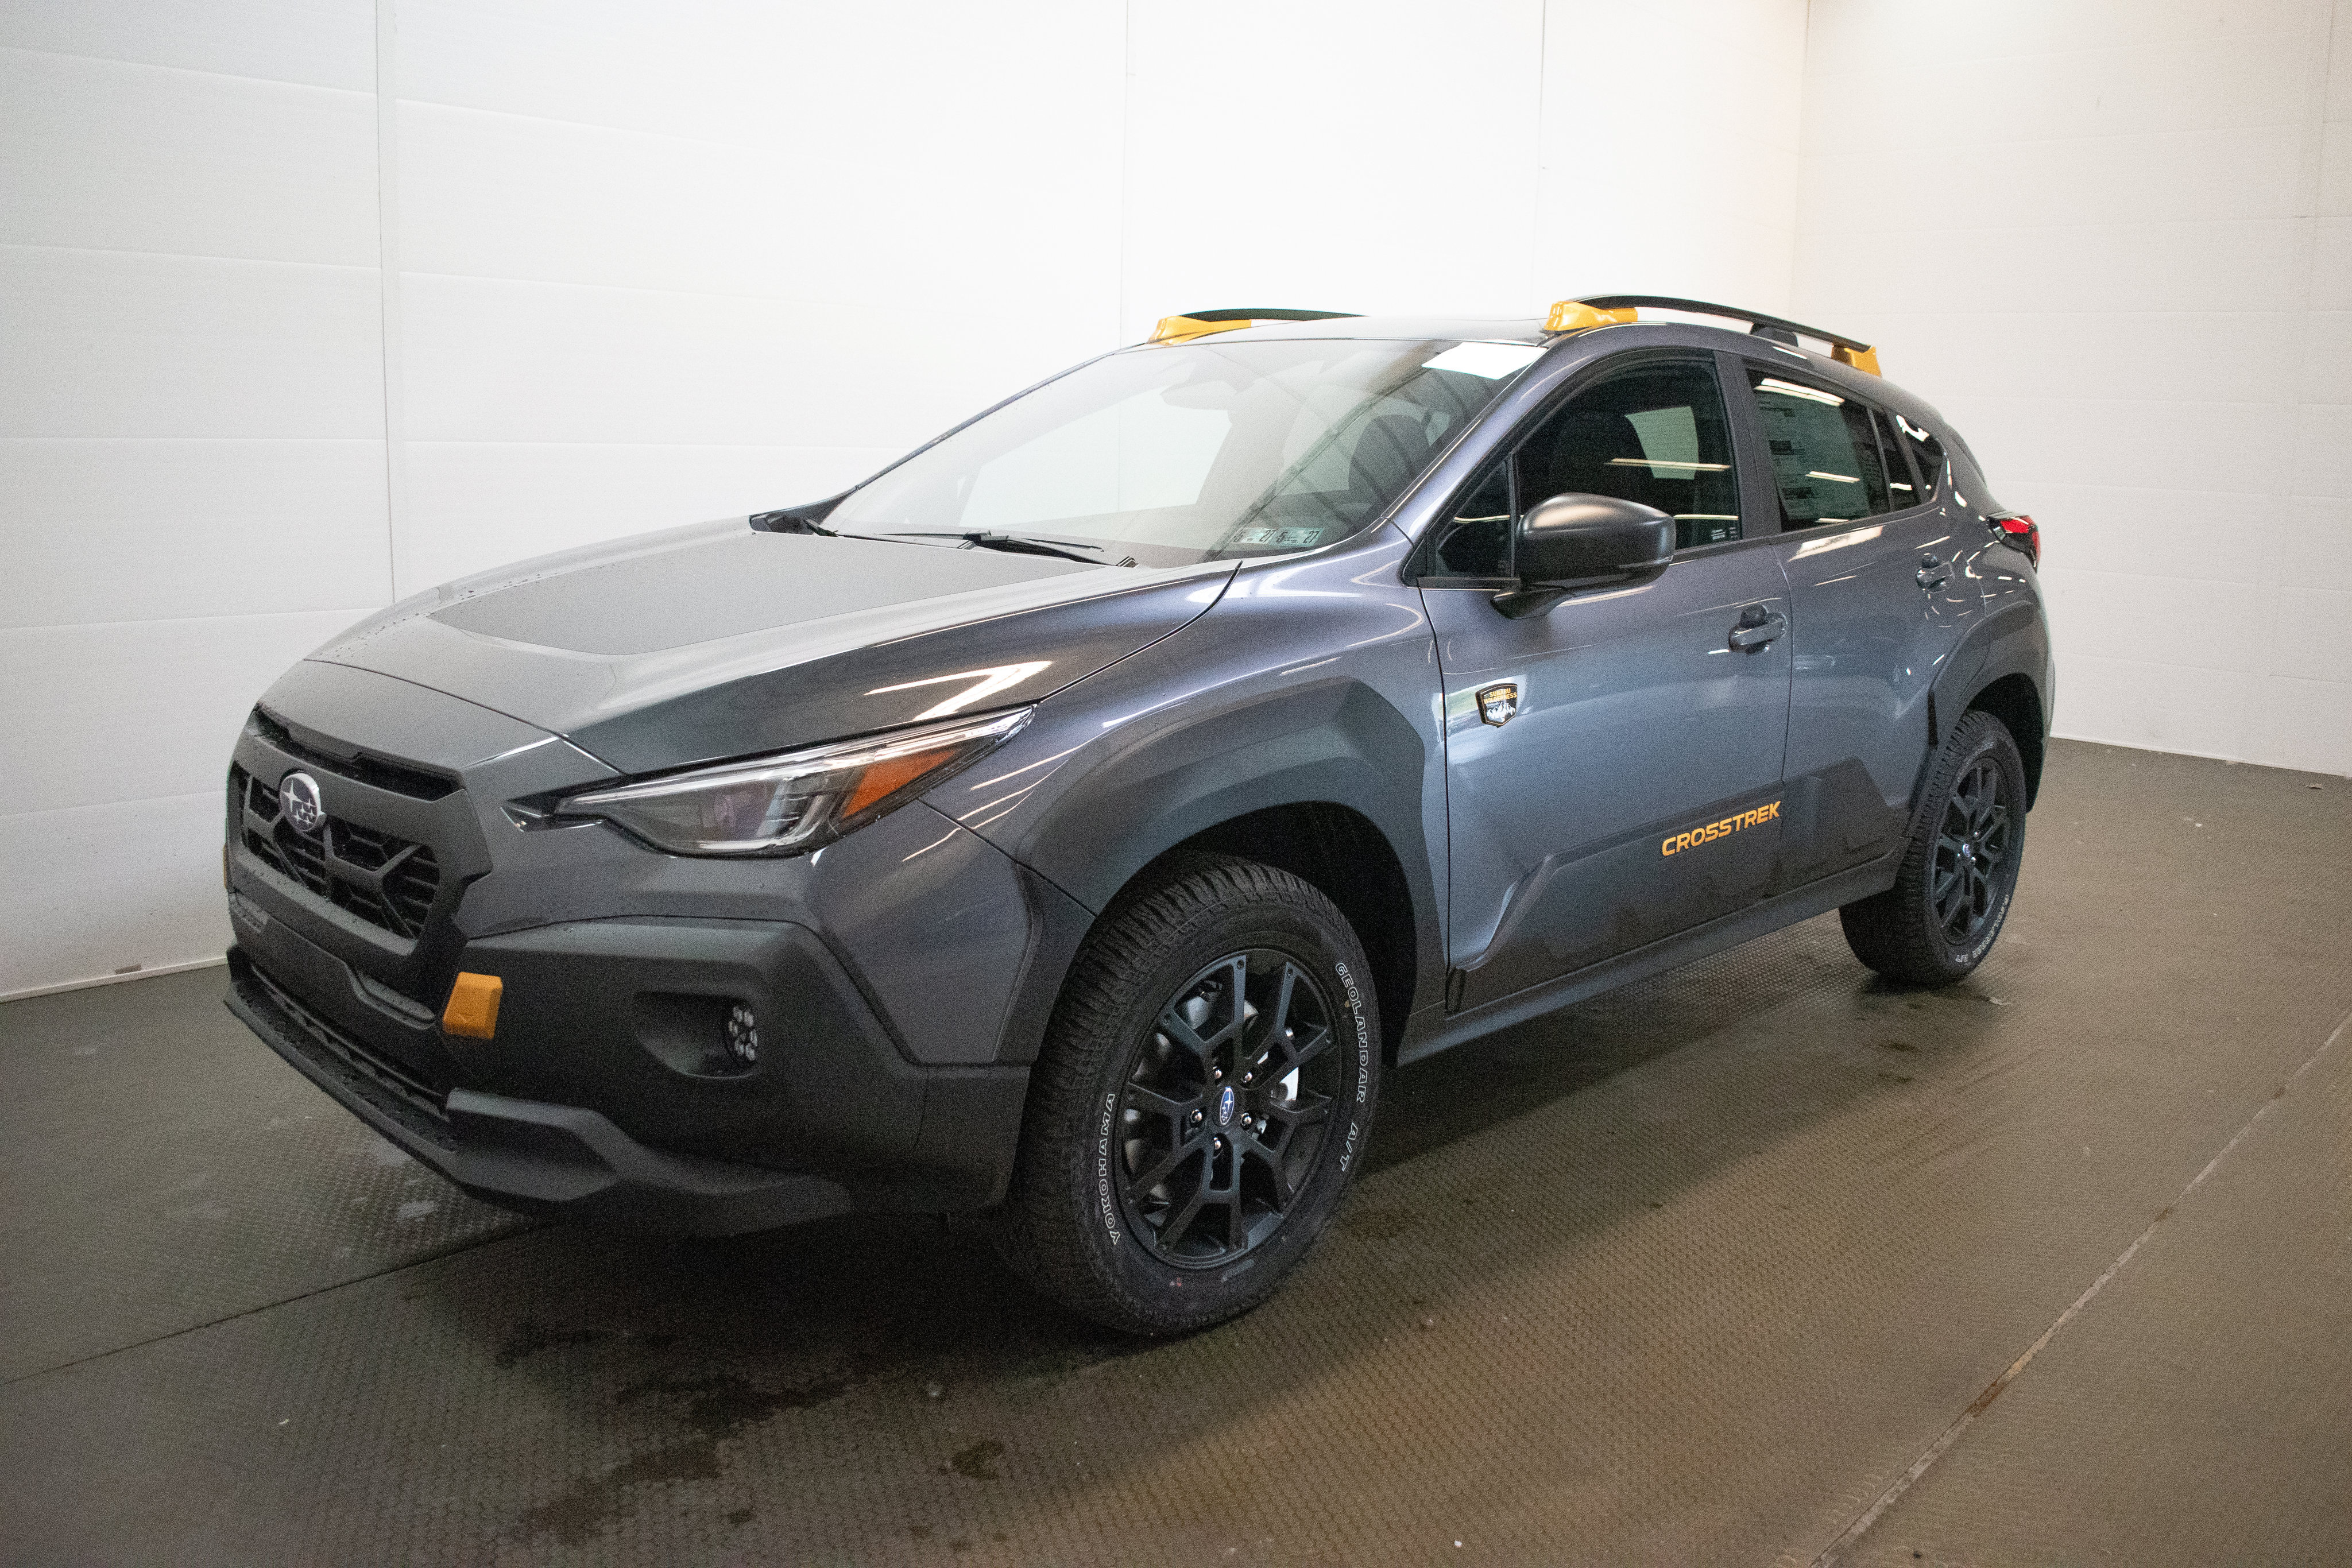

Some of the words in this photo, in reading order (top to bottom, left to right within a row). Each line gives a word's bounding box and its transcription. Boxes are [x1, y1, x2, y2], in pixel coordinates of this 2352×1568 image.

[1259, 529, 1276, 541] 27
[1303, 531, 1320, 543] 27
[1483, 692, 1517, 704] WILDERNESS
[1490, 688, 1511, 697] SUBARU
[1661, 801, 1781, 856] CROSSTREK
[1336, 962, 1368, 1102] GEOLANDAR
[1340, 1122, 1358, 1171] A/T
[1098, 1094, 1120, 1245] YOKOHAMA
